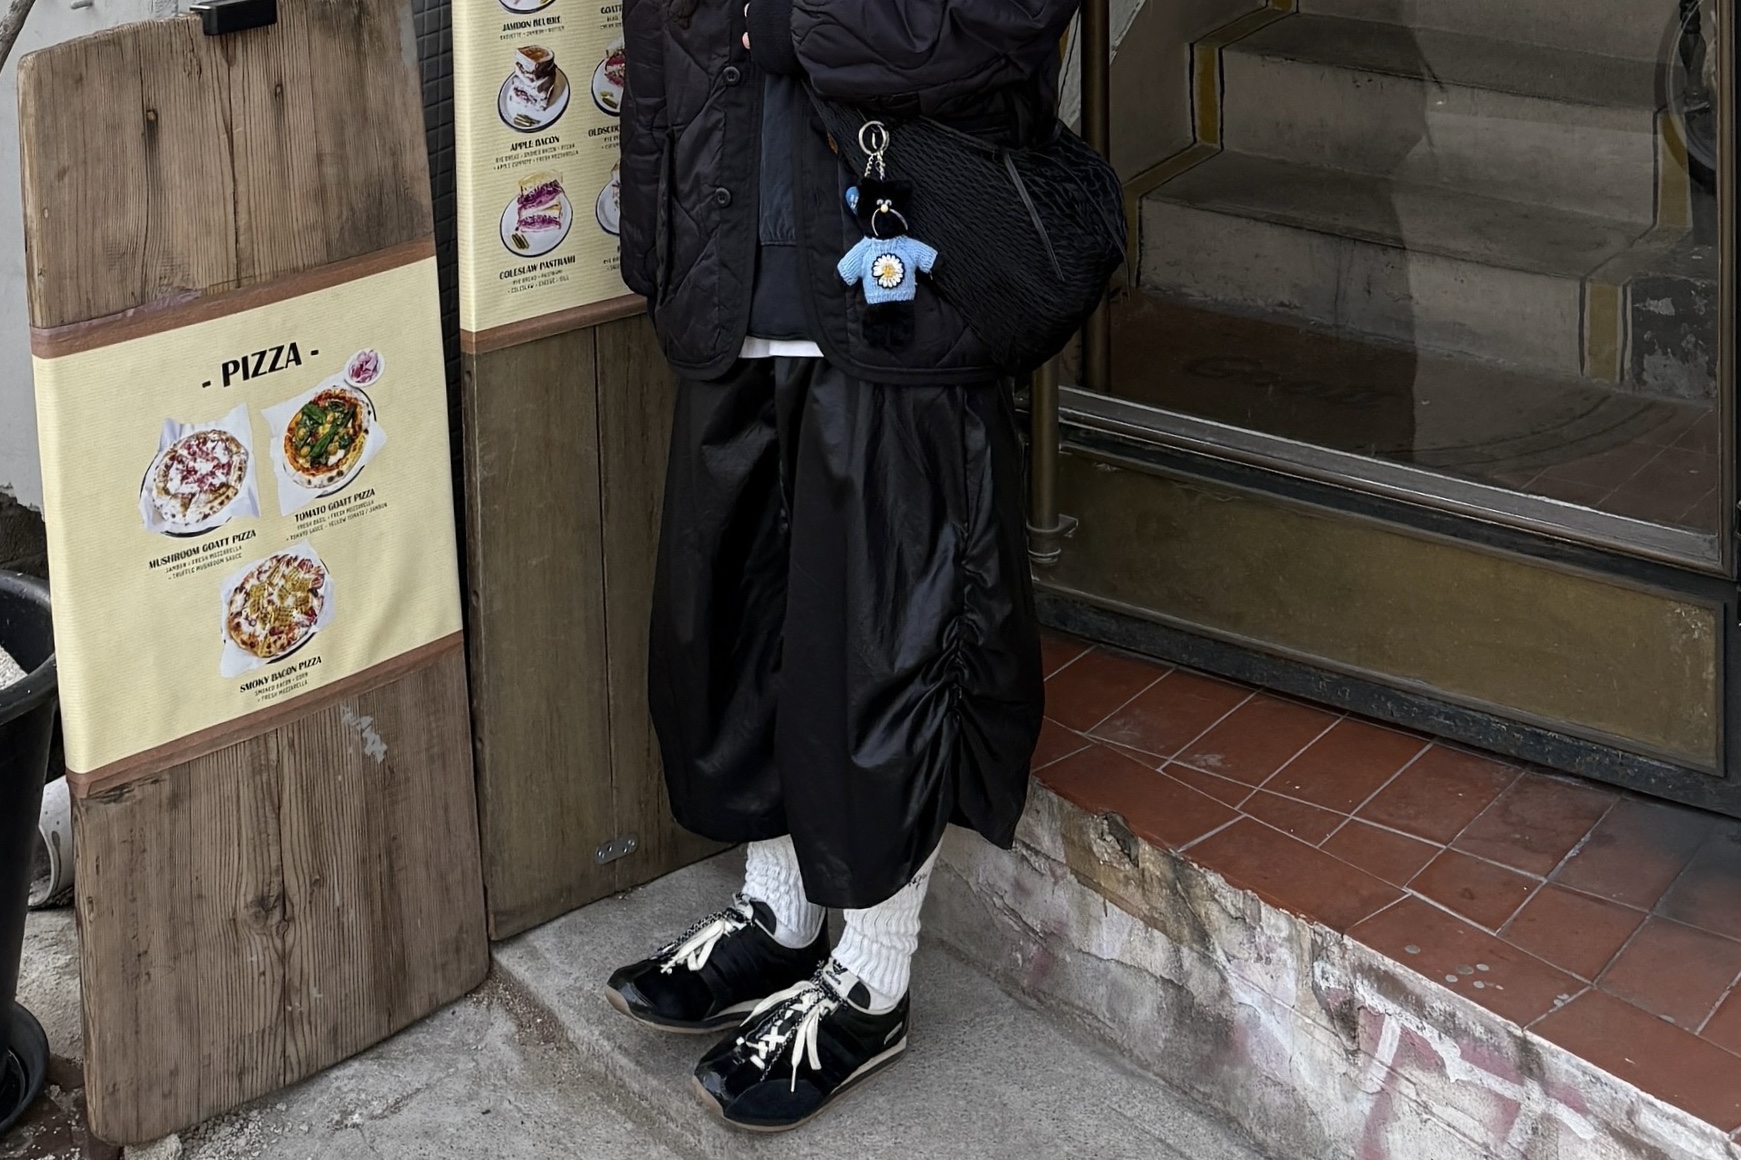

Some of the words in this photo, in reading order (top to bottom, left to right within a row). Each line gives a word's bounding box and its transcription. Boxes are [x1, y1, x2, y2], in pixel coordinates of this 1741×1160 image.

[510, 140, 533, 151] APPLE
[499, 263, 538, 280] COLESLAW
[539, 255, 576, 270] PASTRAMI
[221, 342, 302, 387] PIZZA
[295, 505, 326, 522] TOMATO
[328, 496, 352, 511] GOATT
[353, 488, 375, 502] PIZZA
[149, 546, 200, 568] MUSHROOM
[202, 537, 229, 552] GOATT
[232, 529, 256, 543] PIZZA
[240, 676, 269, 693] SMOKY
[271, 665, 297, 682] BACON
[298, 656, 322, 670] PIZZA
